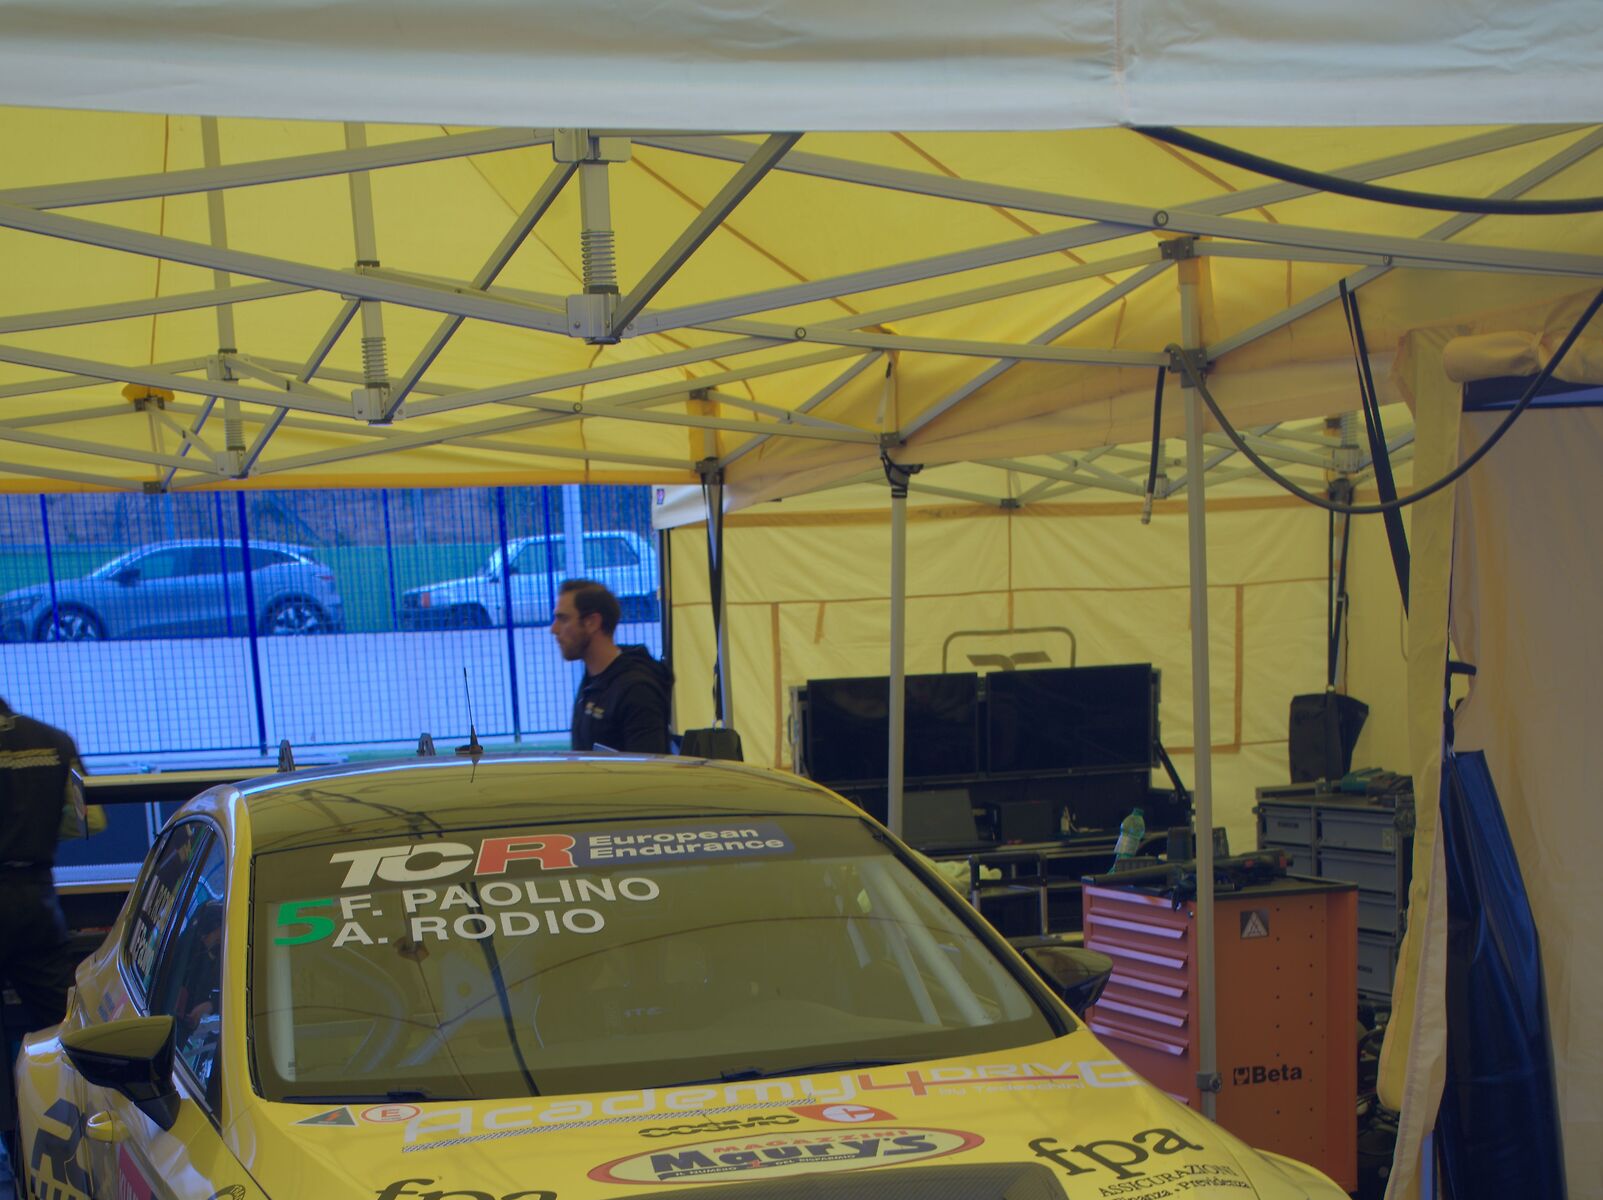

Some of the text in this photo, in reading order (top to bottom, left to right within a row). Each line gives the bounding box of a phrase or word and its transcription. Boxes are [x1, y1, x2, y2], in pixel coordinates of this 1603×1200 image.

[588, 825, 759, 847] European
[588, 838, 785, 860] Endurance
[330, 833, 577, 888] TCR
[341, 876, 660, 919] F. PAOLINO
[274, 899, 333, 946] 5
[332, 908, 605, 947] A. RODIO
[1251, 1065, 1302, 1084] Beta
[650, 1135, 937, 1173] Maury's
[1028, 1128, 1205, 1180] fpa
[1098, 1163, 1238, 1197] ASSICURAZIONI
